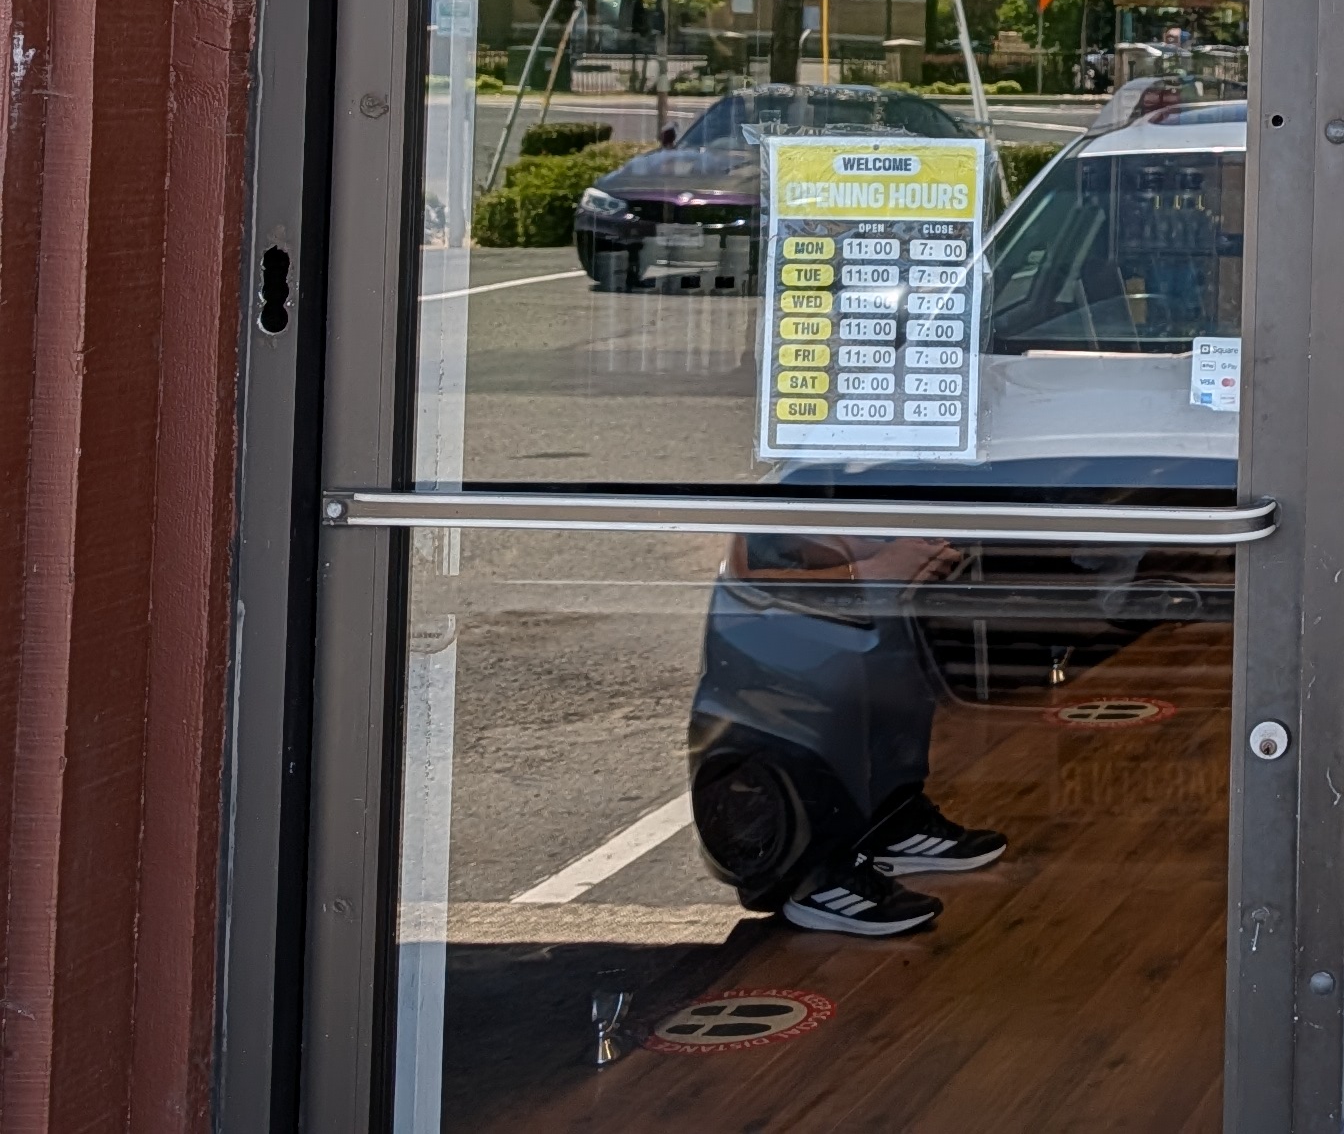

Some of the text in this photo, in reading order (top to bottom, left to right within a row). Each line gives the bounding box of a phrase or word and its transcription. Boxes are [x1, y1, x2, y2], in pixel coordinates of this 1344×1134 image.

[842, 156, 913, 172] WELCOME
[785, 182, 969, 211] OPENING HOURS
[858, 223, 955, 235] OPEN CLOSE
[793, 241, 825, 255] MON
[794, 268, 822, 282] TUE
[792, 295, 823, 309] WED
[792, 322, 821, 336] THU
[794, 348, 816, 362] FRI
[1212, 346, 1239, 356] Square
[789, 375, 818, 389] SAT
[1200, 378, 1216, 386] VISA
[788, 402, 817, 416] SUN
